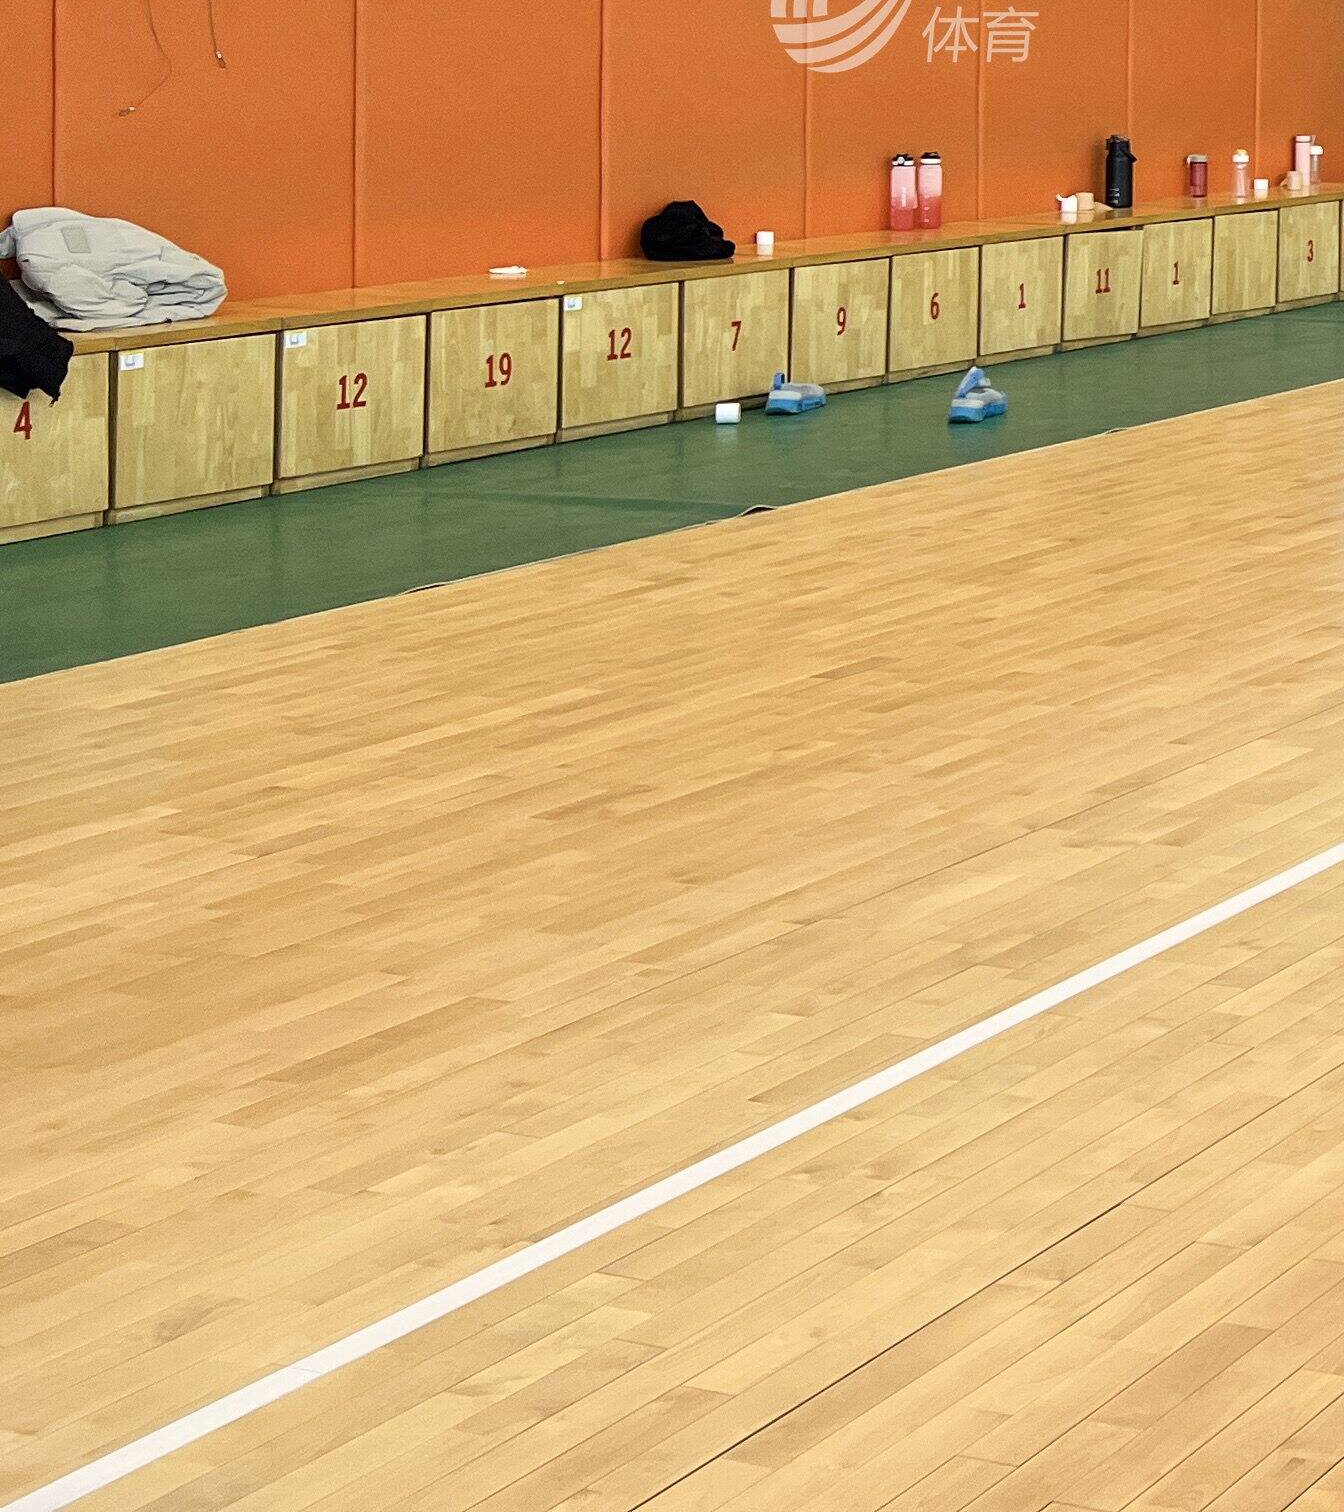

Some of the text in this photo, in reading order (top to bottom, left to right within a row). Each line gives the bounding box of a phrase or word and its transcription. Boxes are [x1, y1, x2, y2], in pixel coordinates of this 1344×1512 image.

[1306, 239, 1315, 262] 3
[1095, 268, 1111, 294] 11
[1172, 261, 1181, 286] 1
[929, 292, 942, 321] 6
[1016, 283, 1027, 310] 1
[835, 306, 848, 336] 9
[606, 327, 633, 362] 12
[730, 320, 743, 353] 7
[485, 352, 513, 388] 19
[336, 372, 368, 410] 12
[13, 401, 33, 440] 4
